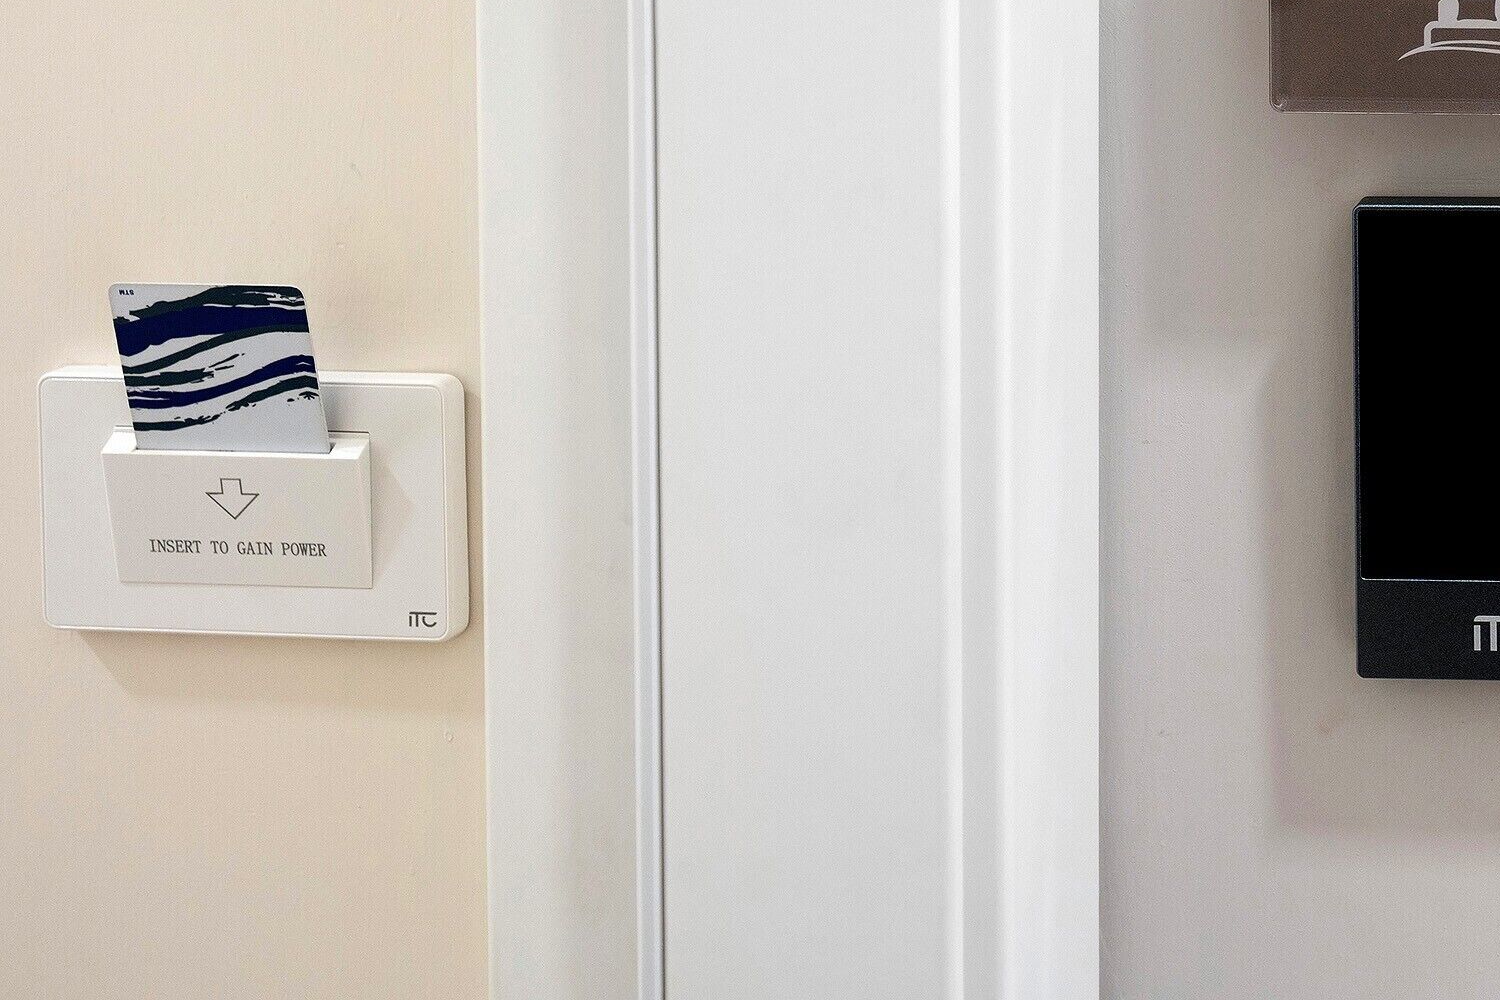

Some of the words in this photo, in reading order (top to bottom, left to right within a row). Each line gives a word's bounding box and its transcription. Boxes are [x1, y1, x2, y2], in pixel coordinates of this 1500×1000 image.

[149, 538, 202, 554] INSERT
[210, 540, 229, 554] TO
[236, 541, 273, 556] GAIN
[280, 542, 327, 557] POWER
